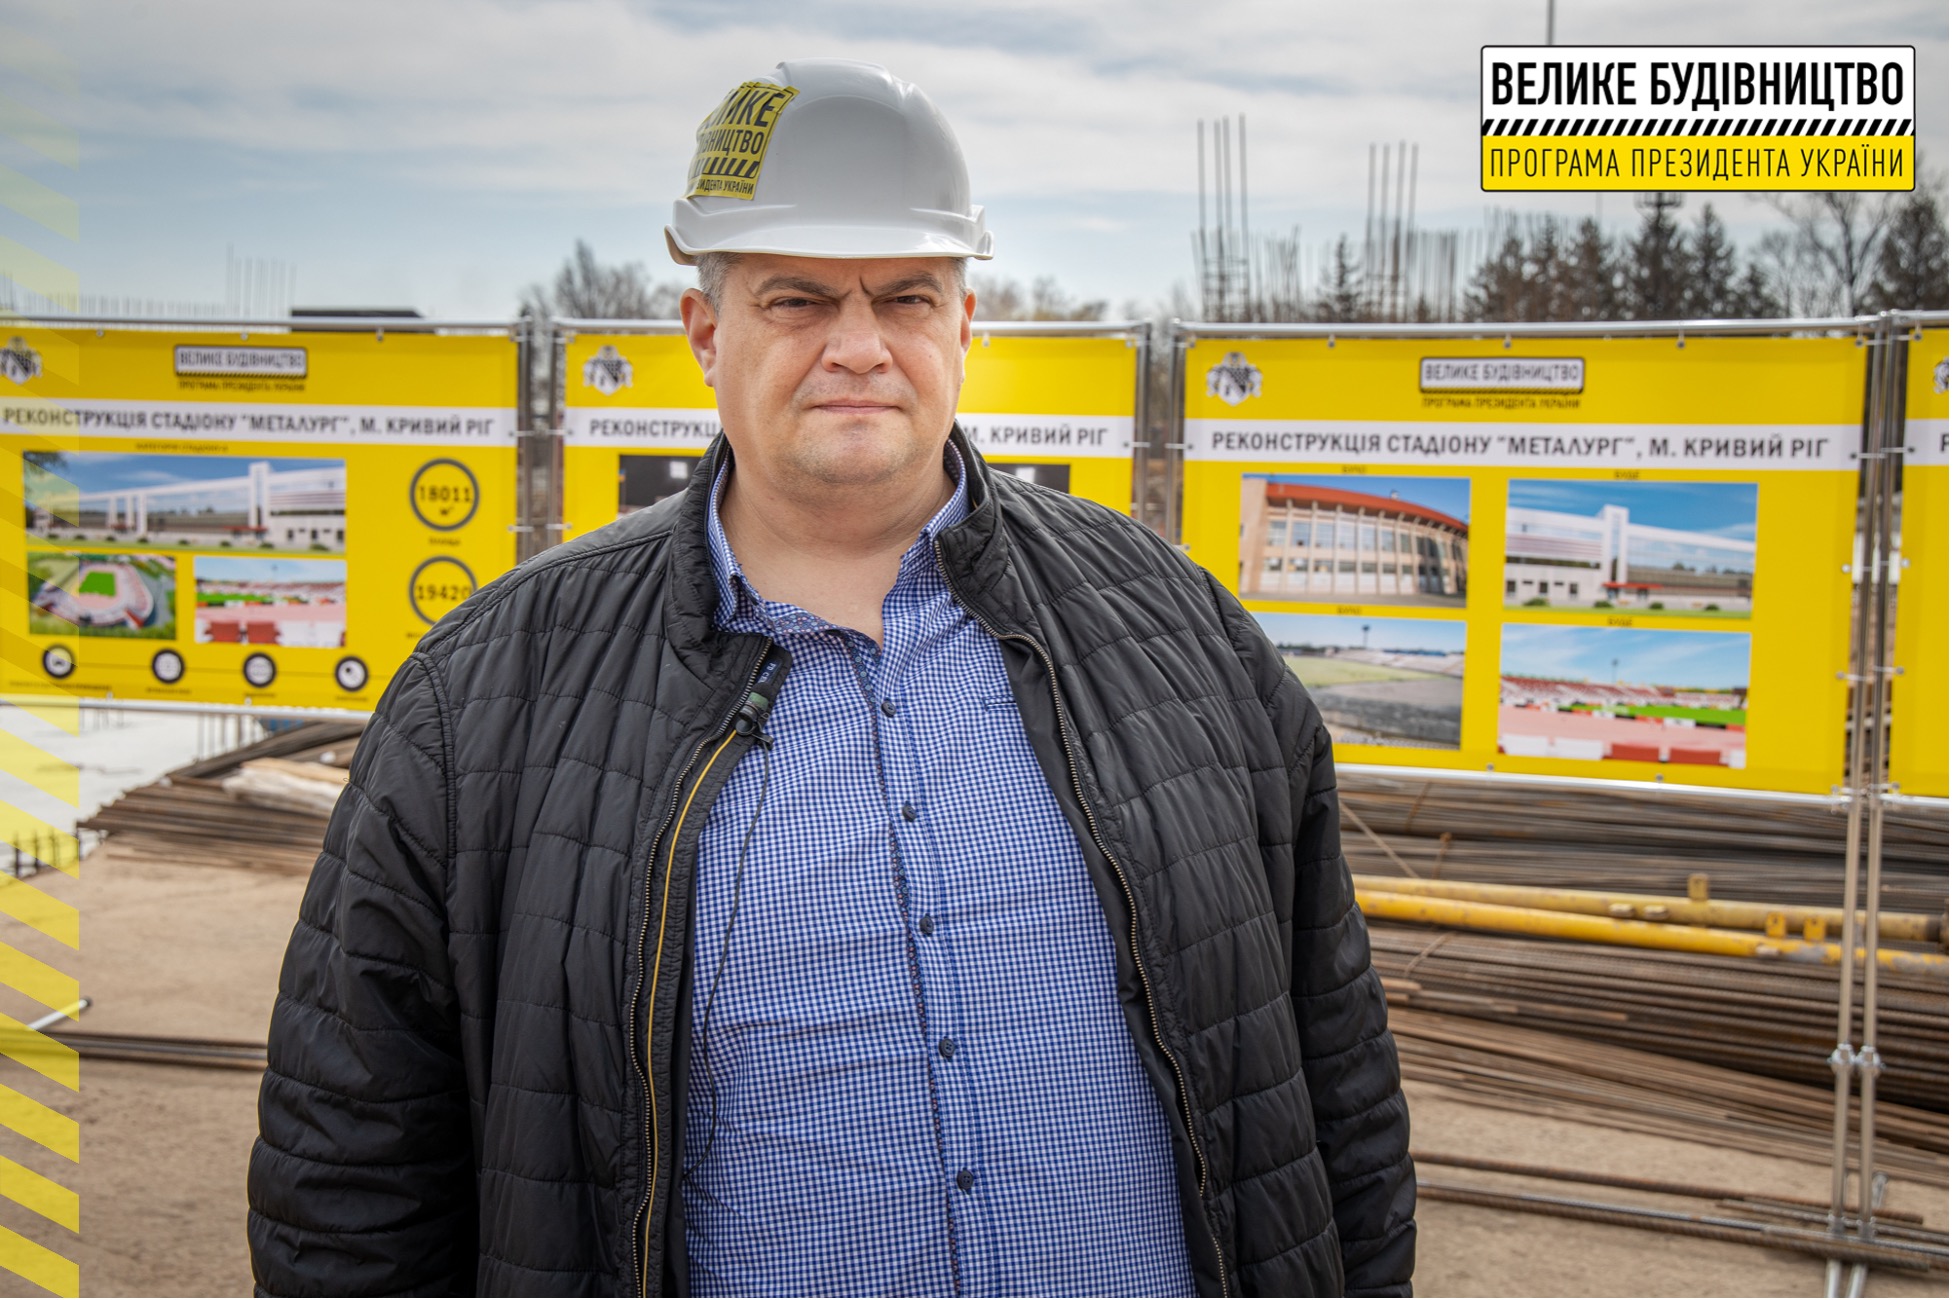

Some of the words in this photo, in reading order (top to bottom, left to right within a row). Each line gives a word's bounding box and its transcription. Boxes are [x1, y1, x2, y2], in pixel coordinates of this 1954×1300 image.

[722, 179, 755, 195] УКРАЇНИ
[1425, 363, 1479, 381] ВЕЛИКЕ
[1482, 363, 1579, 383] БУДІВНИЦТВО
[4, 407, 147, 430] РЕКОНСТРУКЦІЯ
[152, 411, 237, 432] СТАДІОНУ
[360, 418, 382, 435] М.
[386, 414, 461, 436] КРИВИЙ
[466, 419, 495, 437] РІГ
[589, 418, 718, 437] РЕКОНСТРУКЦ
[990, 423, 1071, 445] КРИВИЙ
[1076, 428, 1108, 446] РІГ
[1211, 431, 1381, 454] РЕКОНСТРУКЦІЯ
[1386, 434, 1492, 456] СТАДІОНУ
[1649, 436, 1677, 458] М.
[1683, 431, 1783, 459] КРИВИЙ
[1789, 437, 1829, 459] РІГ
[419, 485, 472, 503] 18011
[417, 584, 472, 602] 19420
